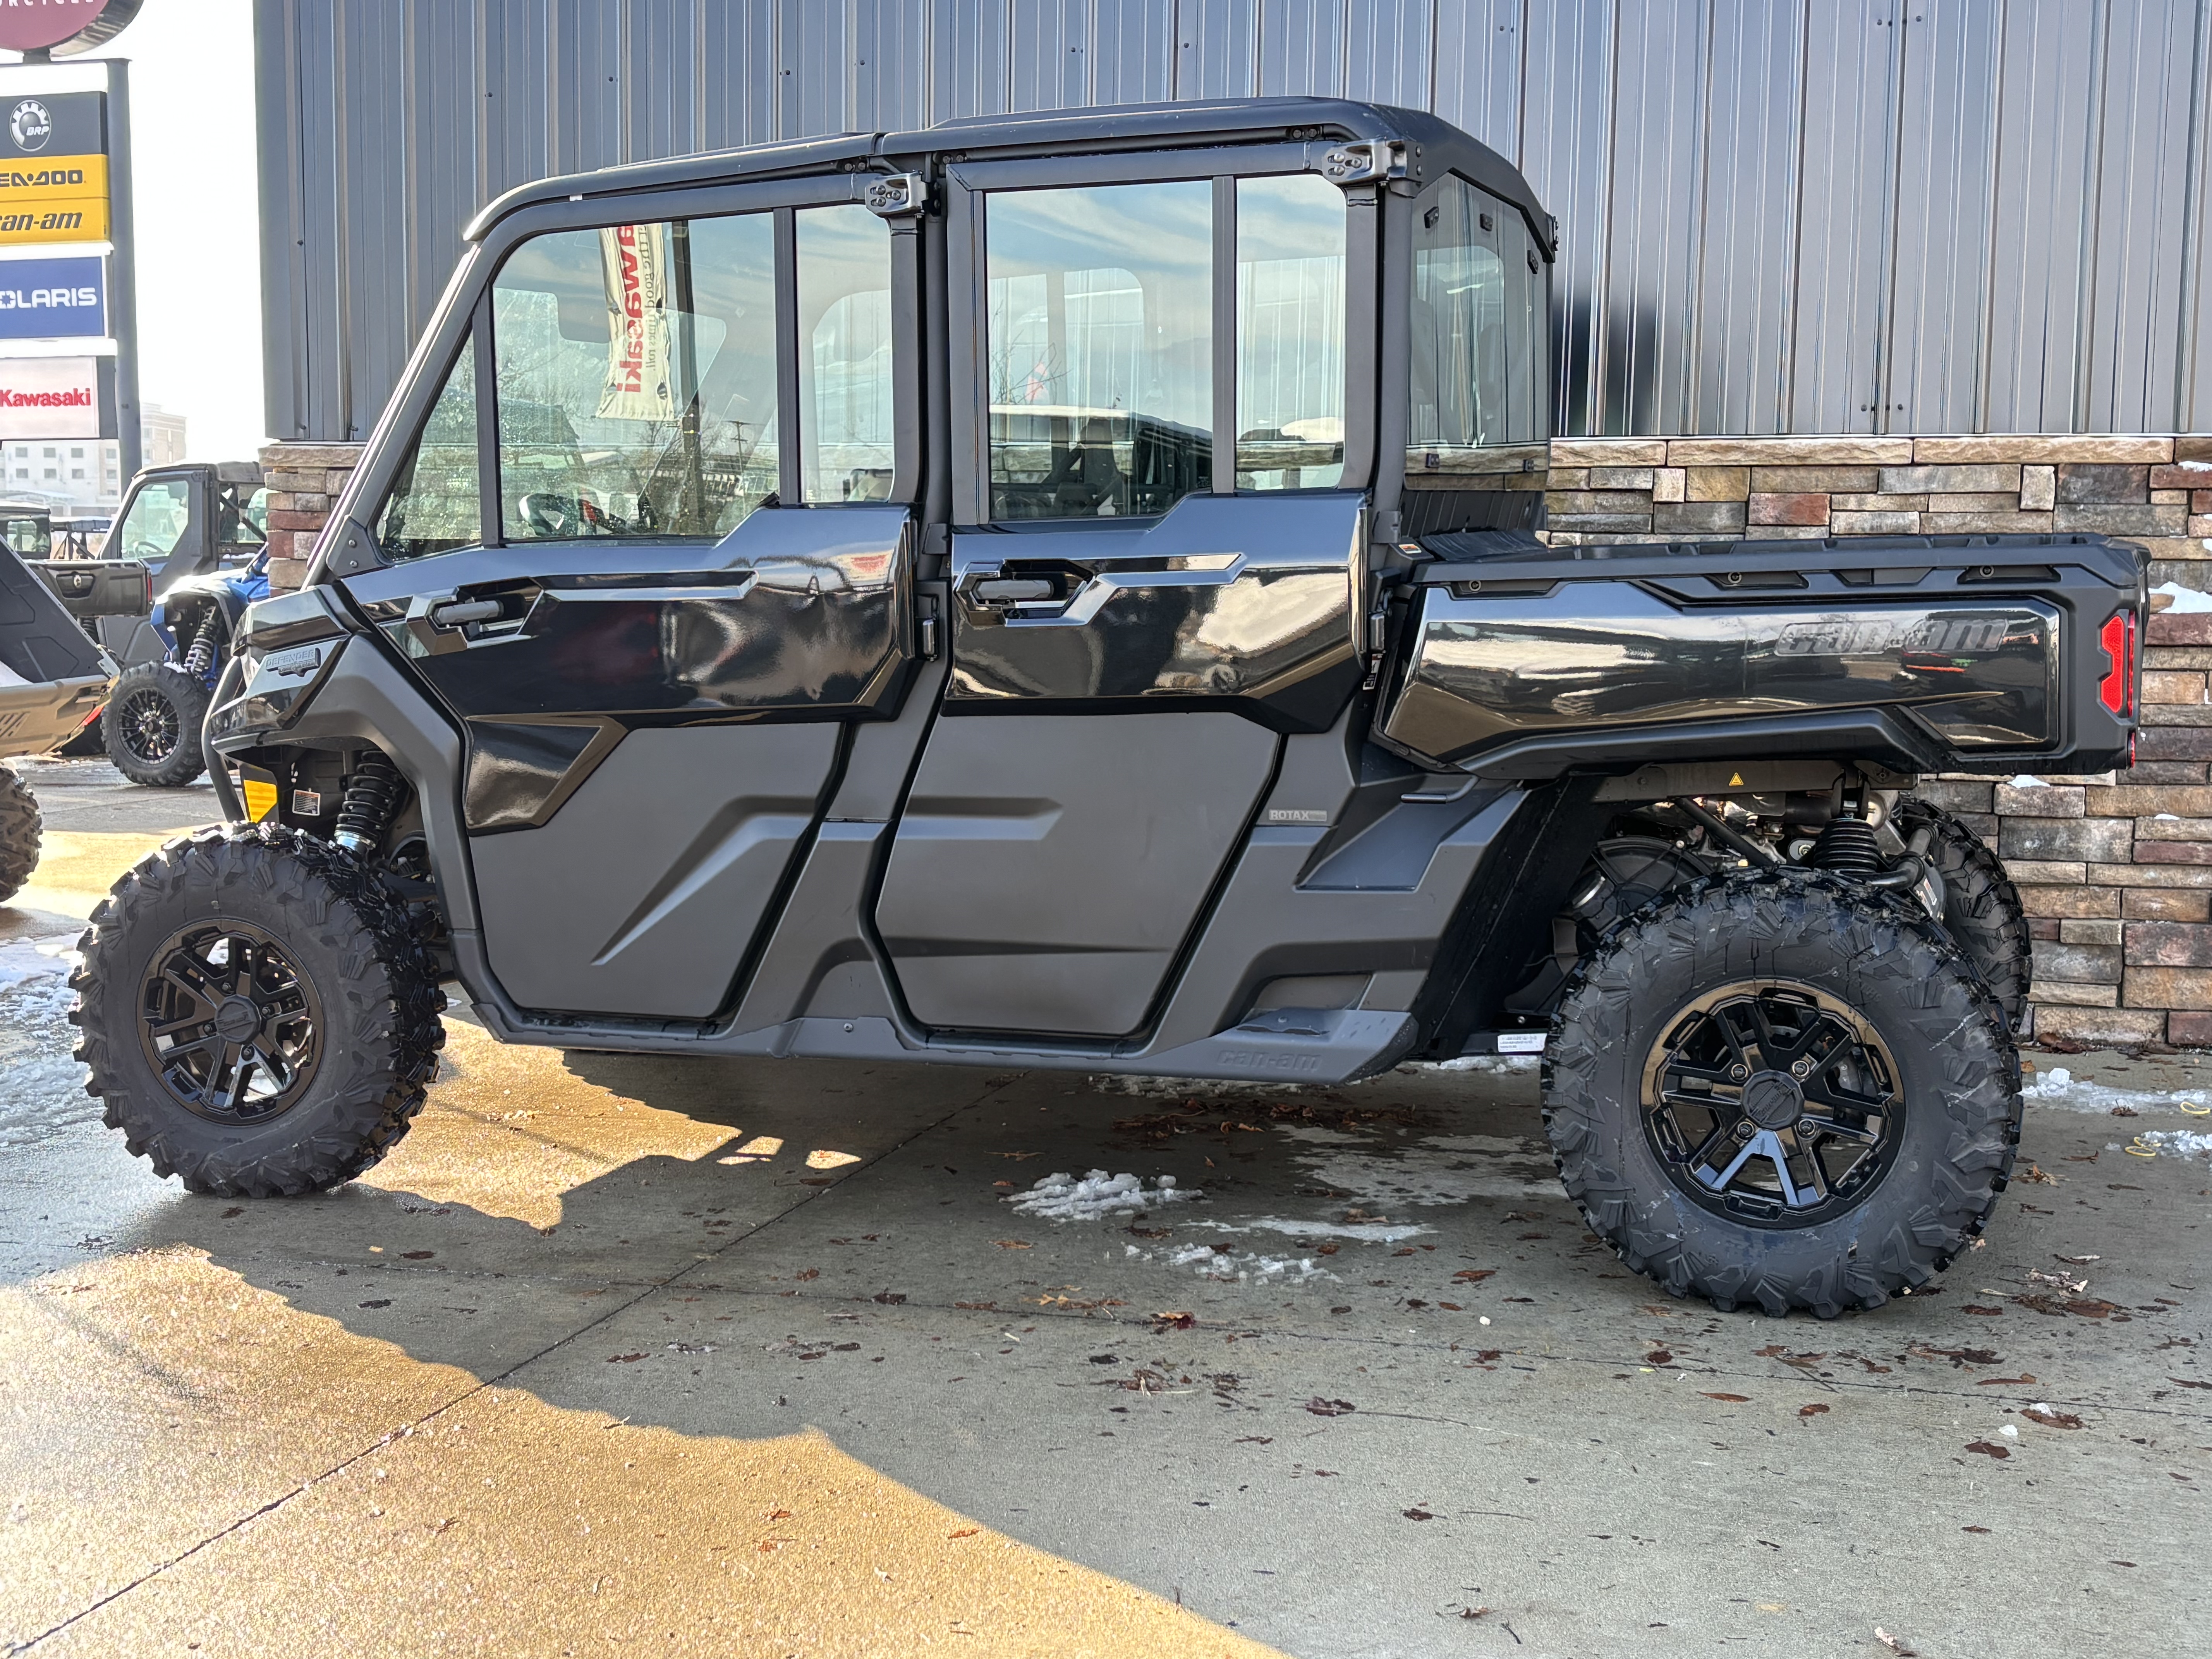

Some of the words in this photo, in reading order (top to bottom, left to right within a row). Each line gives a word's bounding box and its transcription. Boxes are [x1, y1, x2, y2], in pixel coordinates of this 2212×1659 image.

[26, 126, 50, 136] BRP
[0, 212, 82, 231] an-am
[0, 388, 91, 407] Kawasaki
[266, 650, 314, 666] DEFENDER
[1270, 810, 1310, 820] ROTAX
